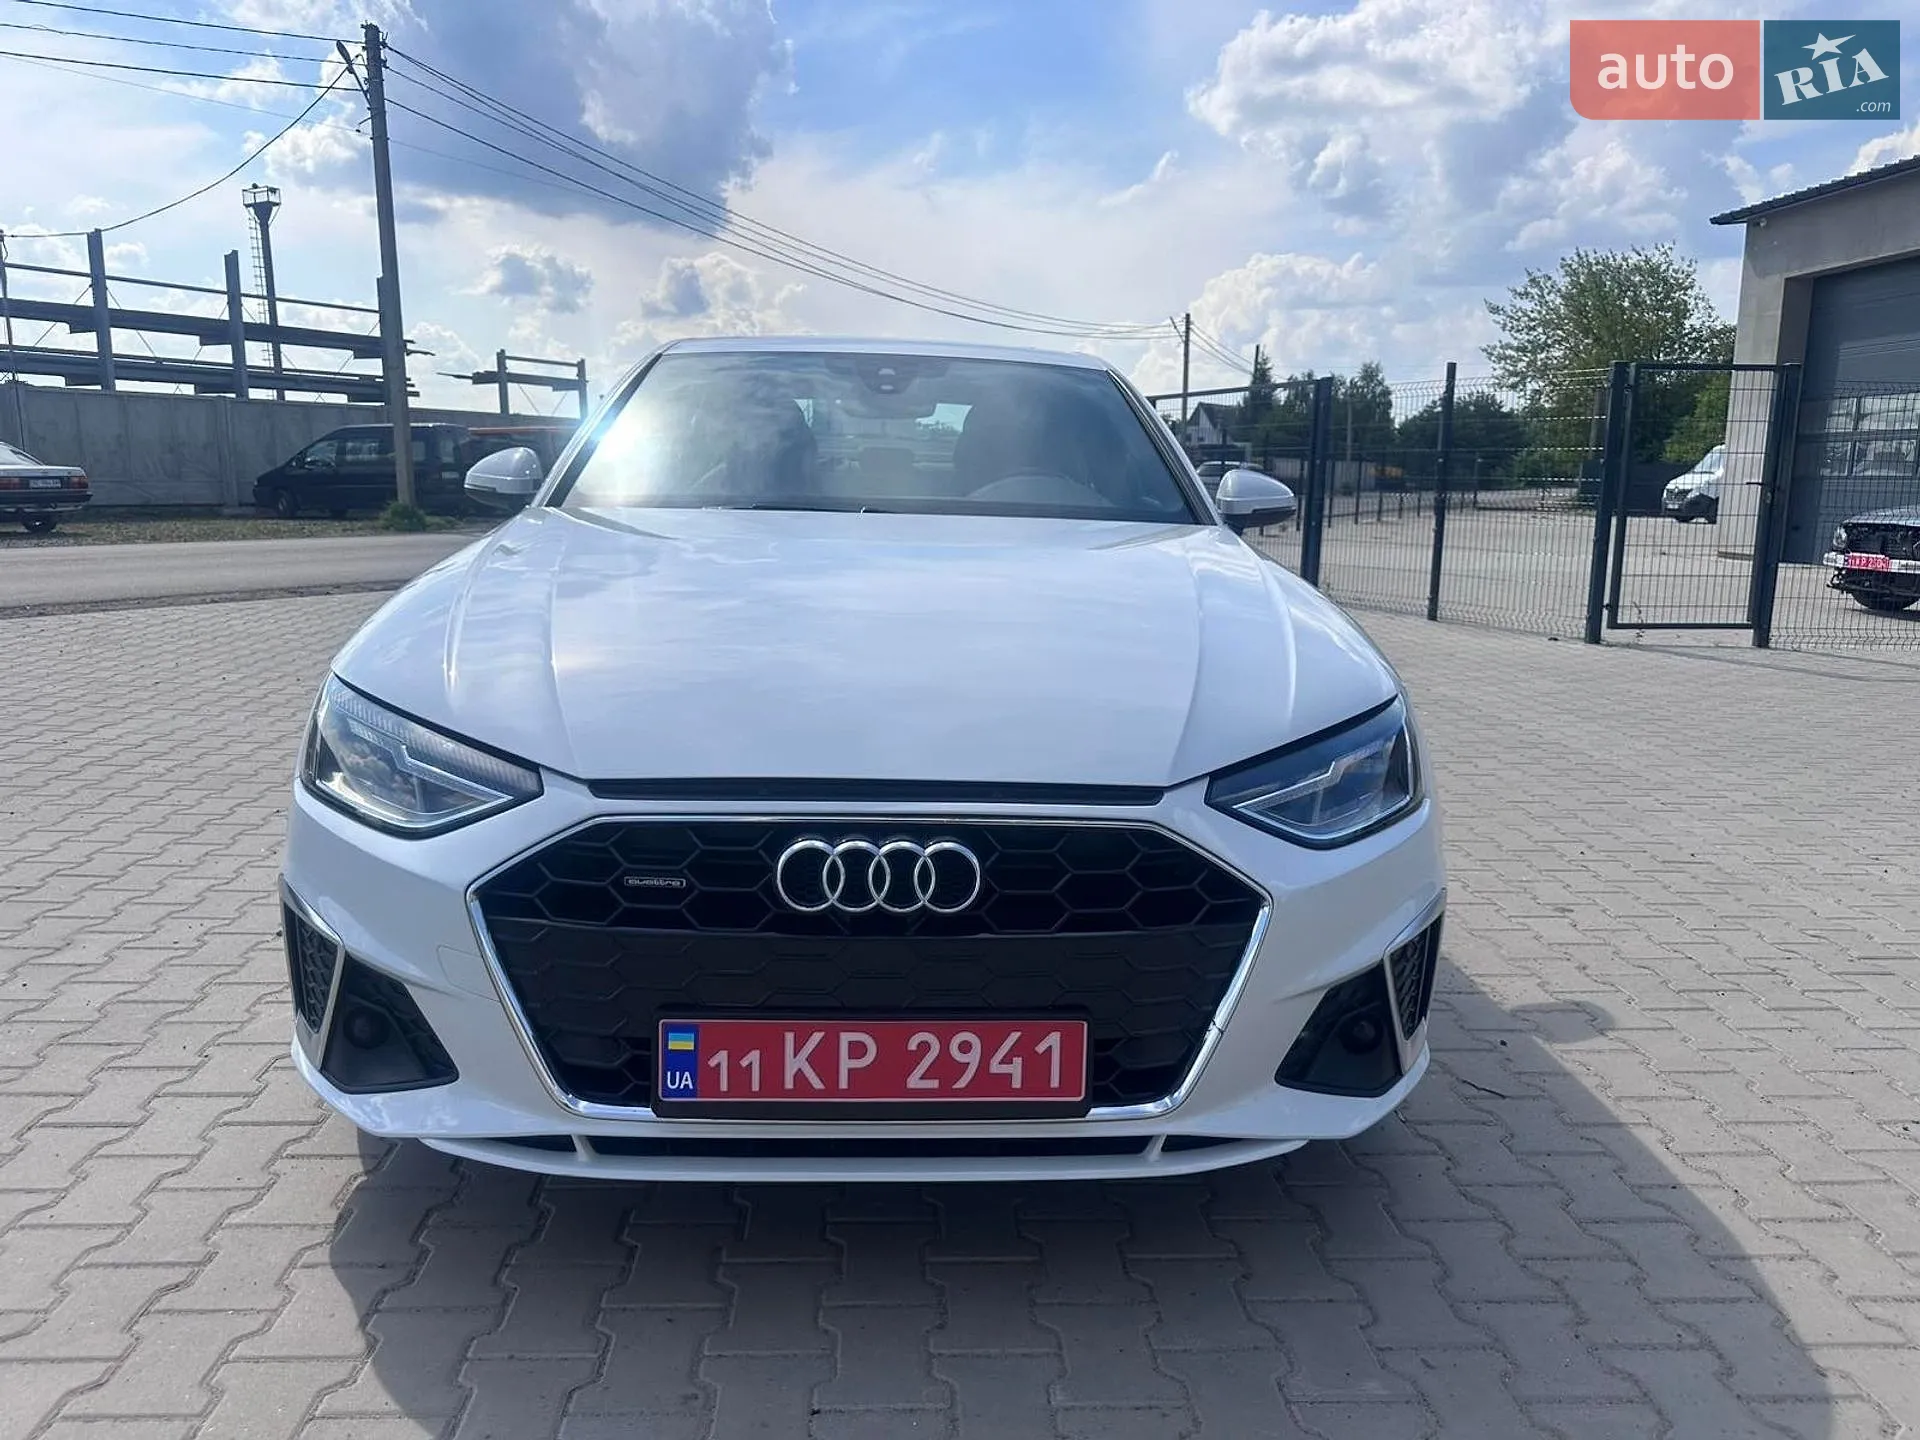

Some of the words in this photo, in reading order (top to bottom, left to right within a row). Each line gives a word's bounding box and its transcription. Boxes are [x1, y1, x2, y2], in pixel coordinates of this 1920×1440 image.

[667, 1071, 694, 1090] UA
[707, 1049, 762, 1092] 11
[784, 1031, 878, 1091] KP
[906, 1031, 1062, 1091] 2941
